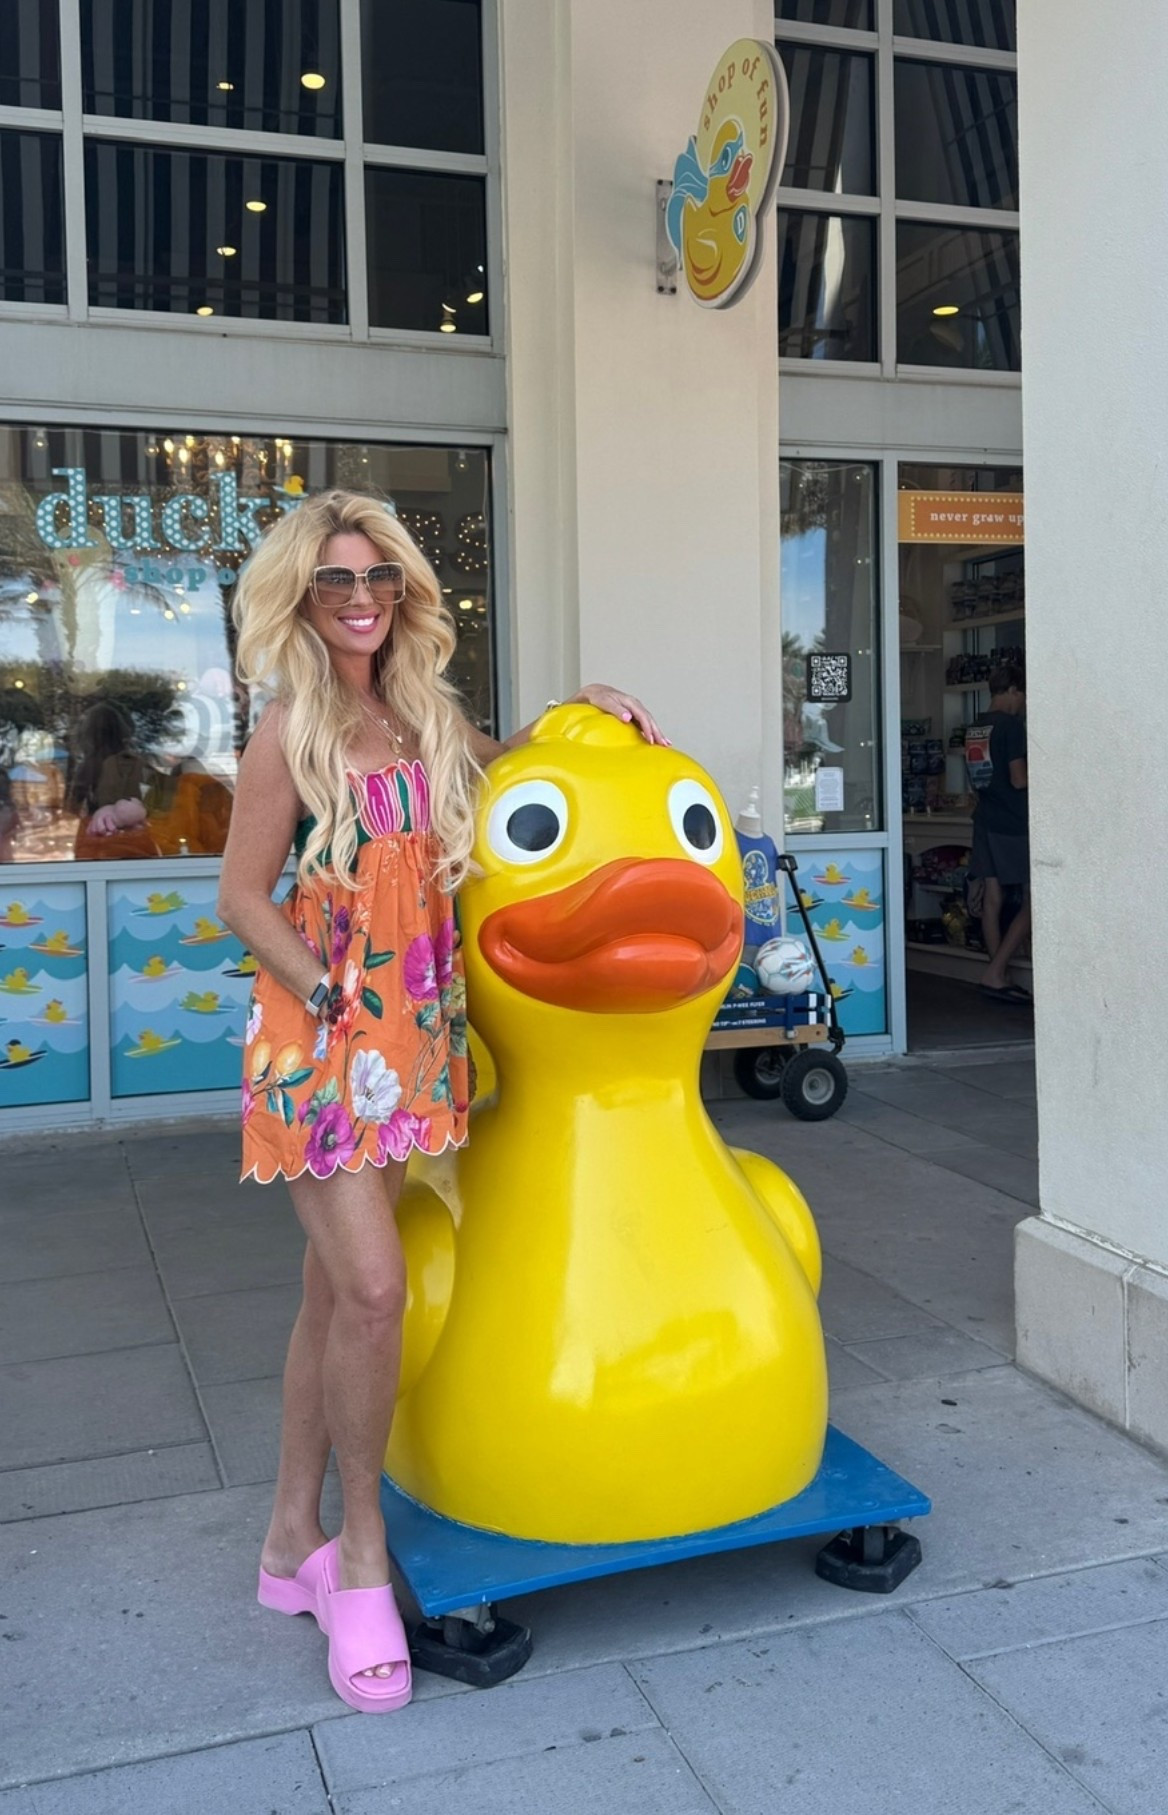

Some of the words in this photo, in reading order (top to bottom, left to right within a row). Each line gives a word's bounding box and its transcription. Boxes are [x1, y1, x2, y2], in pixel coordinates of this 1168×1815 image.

[703, 61, 736, 131] shop
[742, 56, 760, 81] of
[756, 79, 769, 148] fun
[930, 511, 968, 522] never
[972, 512, 1005, 526] grow
[1008, 513, 1024, 526] up
[123, 557, 206, 591] shop
